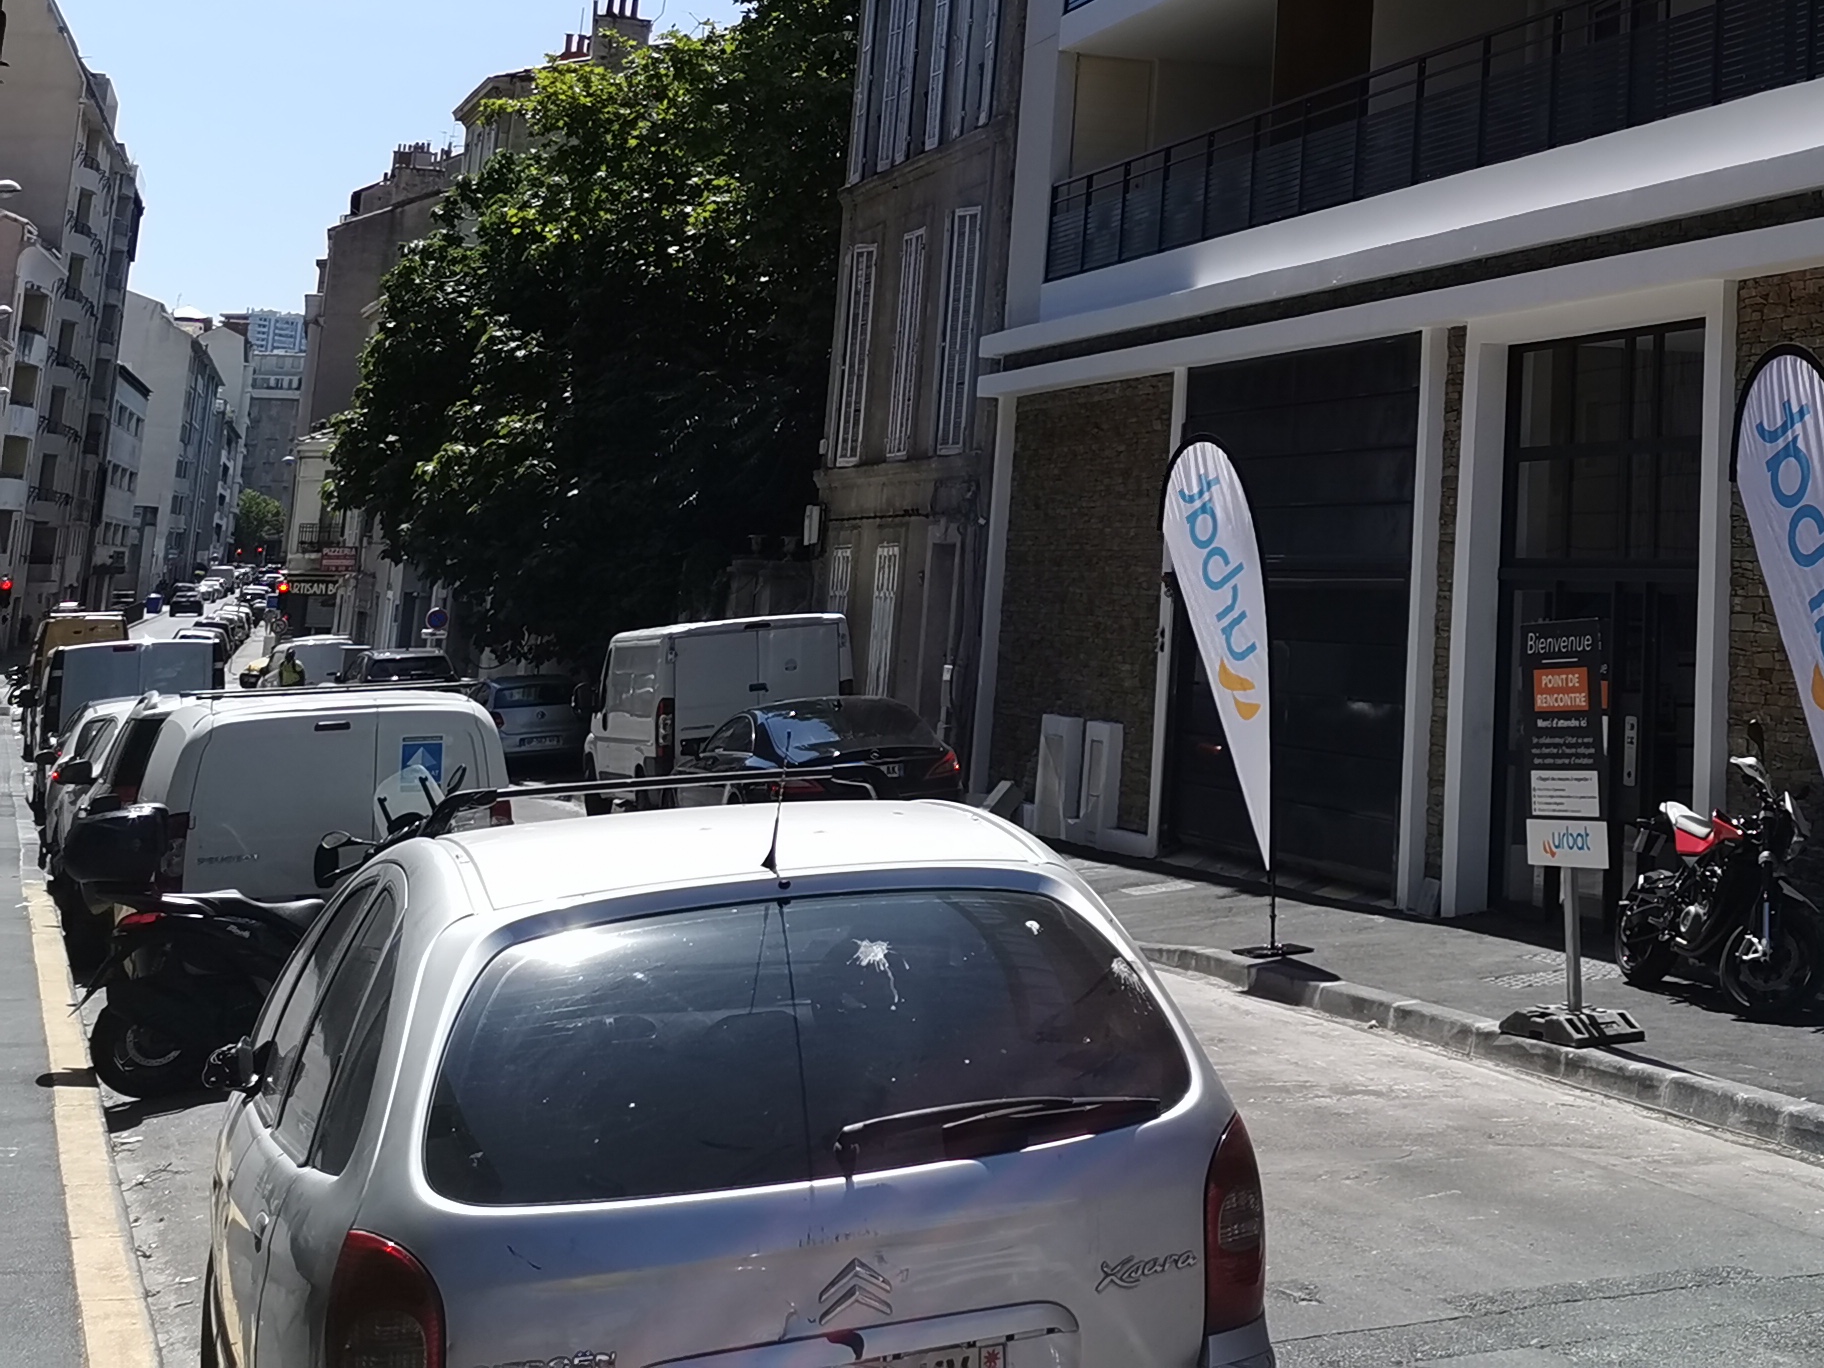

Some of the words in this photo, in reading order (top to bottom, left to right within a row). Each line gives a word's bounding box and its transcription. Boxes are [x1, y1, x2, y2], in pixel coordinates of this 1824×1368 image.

[322, 547, 356, 556] PIZZERIA
[1527, 632, 1592, 654] Bienvenue
[1541, 674, 1567, 688] POINT
[1568, 674, 1580, 687] DE
[1536, 693, 1587, 707] RENCONTRE
[1552, 826, 1591, 851] urbat
[1095, 1250, 1198, 1294] Xsara
